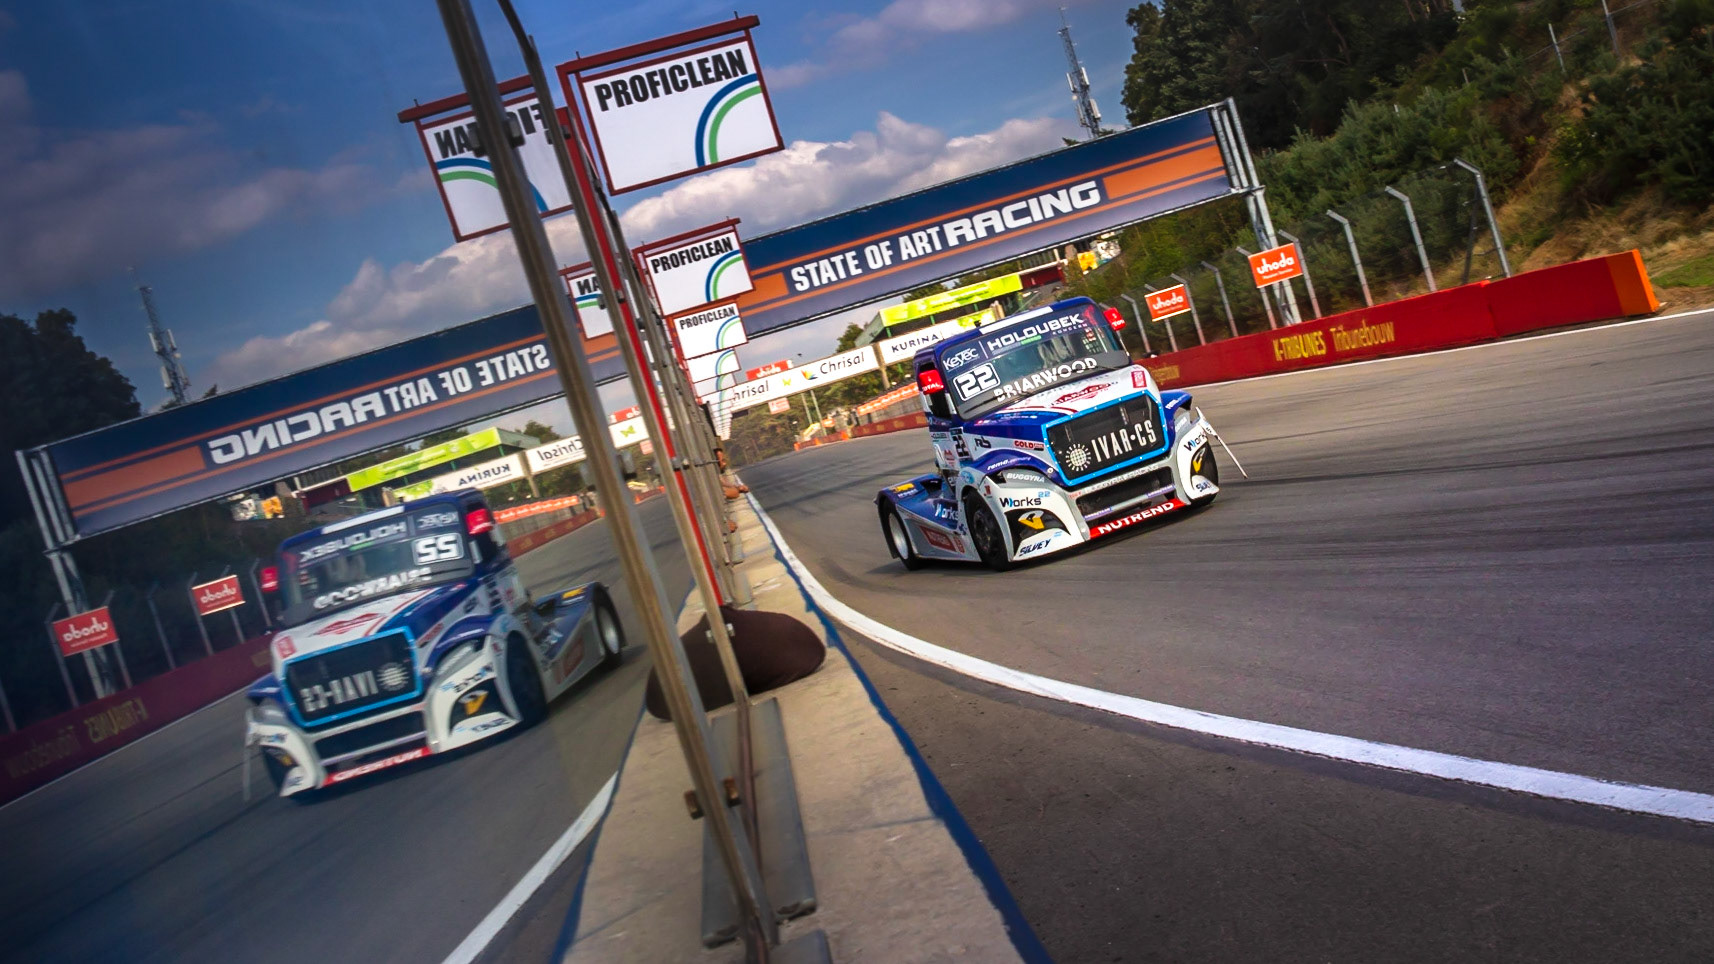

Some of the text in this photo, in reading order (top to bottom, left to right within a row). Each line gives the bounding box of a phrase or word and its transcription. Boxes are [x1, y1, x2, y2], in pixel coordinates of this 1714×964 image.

[594, 48, 748, 111] PROFICLEAN
[791, 180, 1101, 292] STATE OF ART RACING
[650, 236, 733, 274] PROFICLEAN
[1256, 252, 1295, 275] uhoda
[1152, 292, 1184, 310] uhoda
[679, 306, 736, 330] PROFICLEAN
[987, 313, 1084, 351] HOLOUBEK
[891, 333, 940, 354] KURINA
[819, 351, 865, 375] Chrisal
[957, 365, 994, 399] 22
[994, 357, 1097, 402] BRIARWOOD
[1000, 496, 1042, 508] Works
[1098, 502, 1175, 534] NUTREND
